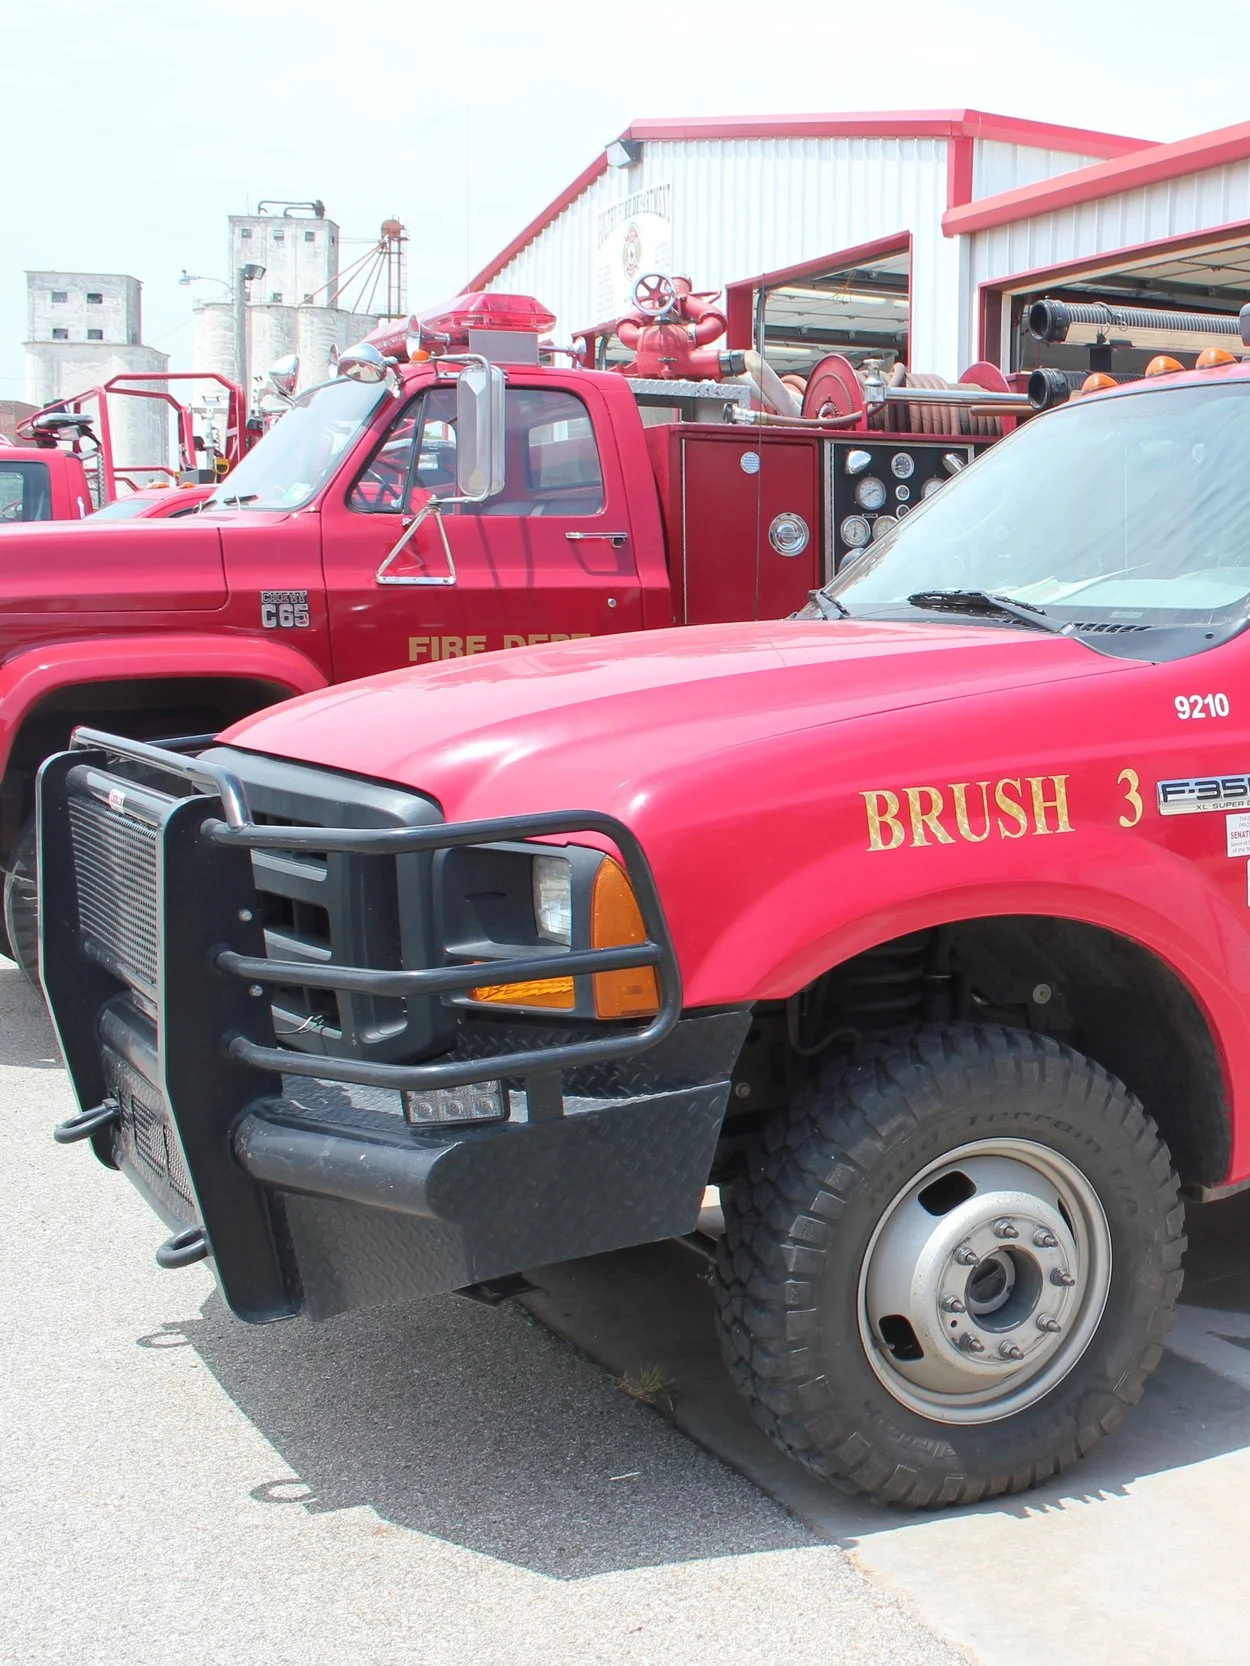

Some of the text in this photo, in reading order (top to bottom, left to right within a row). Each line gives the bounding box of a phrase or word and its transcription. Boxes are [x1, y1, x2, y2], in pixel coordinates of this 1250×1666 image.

[260, 590, 308, 604] CHEVY
[261, 603, 310, 628] C65
[408, 635, 487, 661] FIRE
[1174, 693, 1230, 720] 9210
[858, 768, 1144, 852] BRUSH 3
[1196, 803, 1208, 811] XL
[1212, 801, 1244, 810] SUPER
